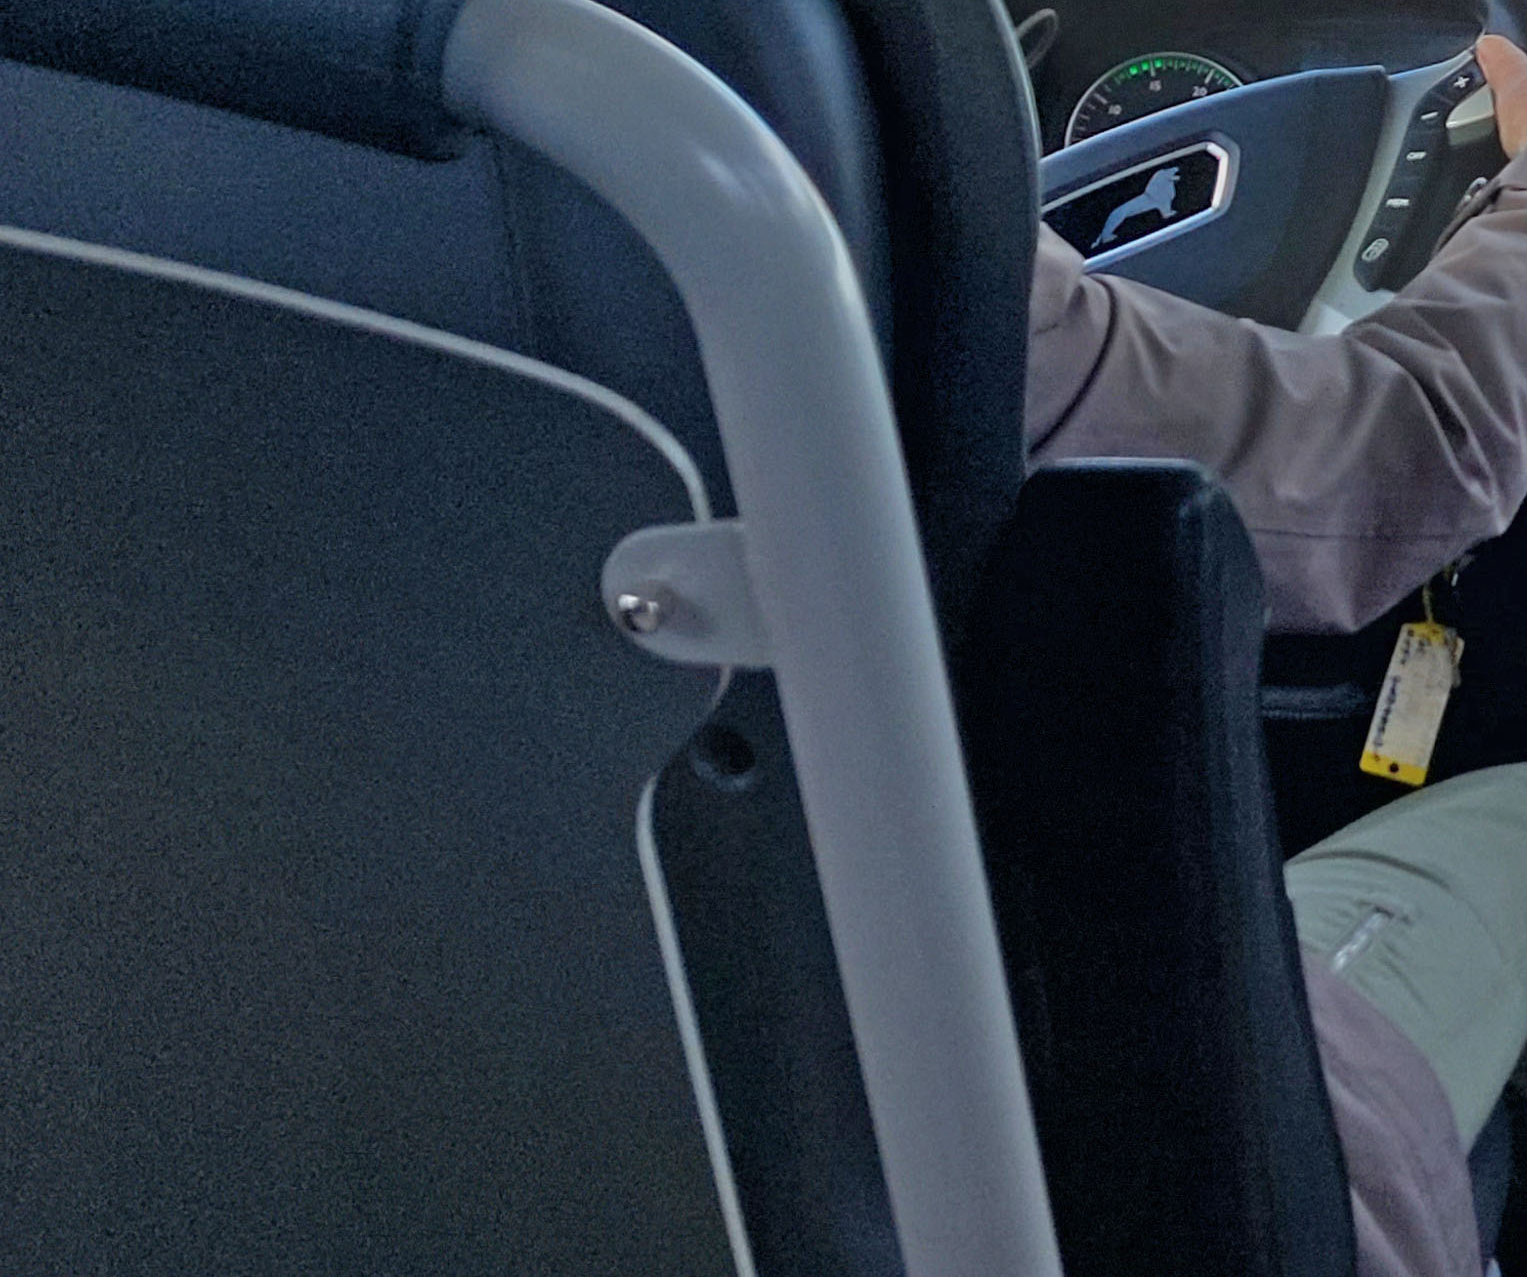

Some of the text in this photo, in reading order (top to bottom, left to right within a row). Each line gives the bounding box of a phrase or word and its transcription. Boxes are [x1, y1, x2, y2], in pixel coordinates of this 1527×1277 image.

[1149, 80, 1162, 91] 15
[1192, 86, 1208, 98] 20
[1108, 104, 1122, 116] 10
